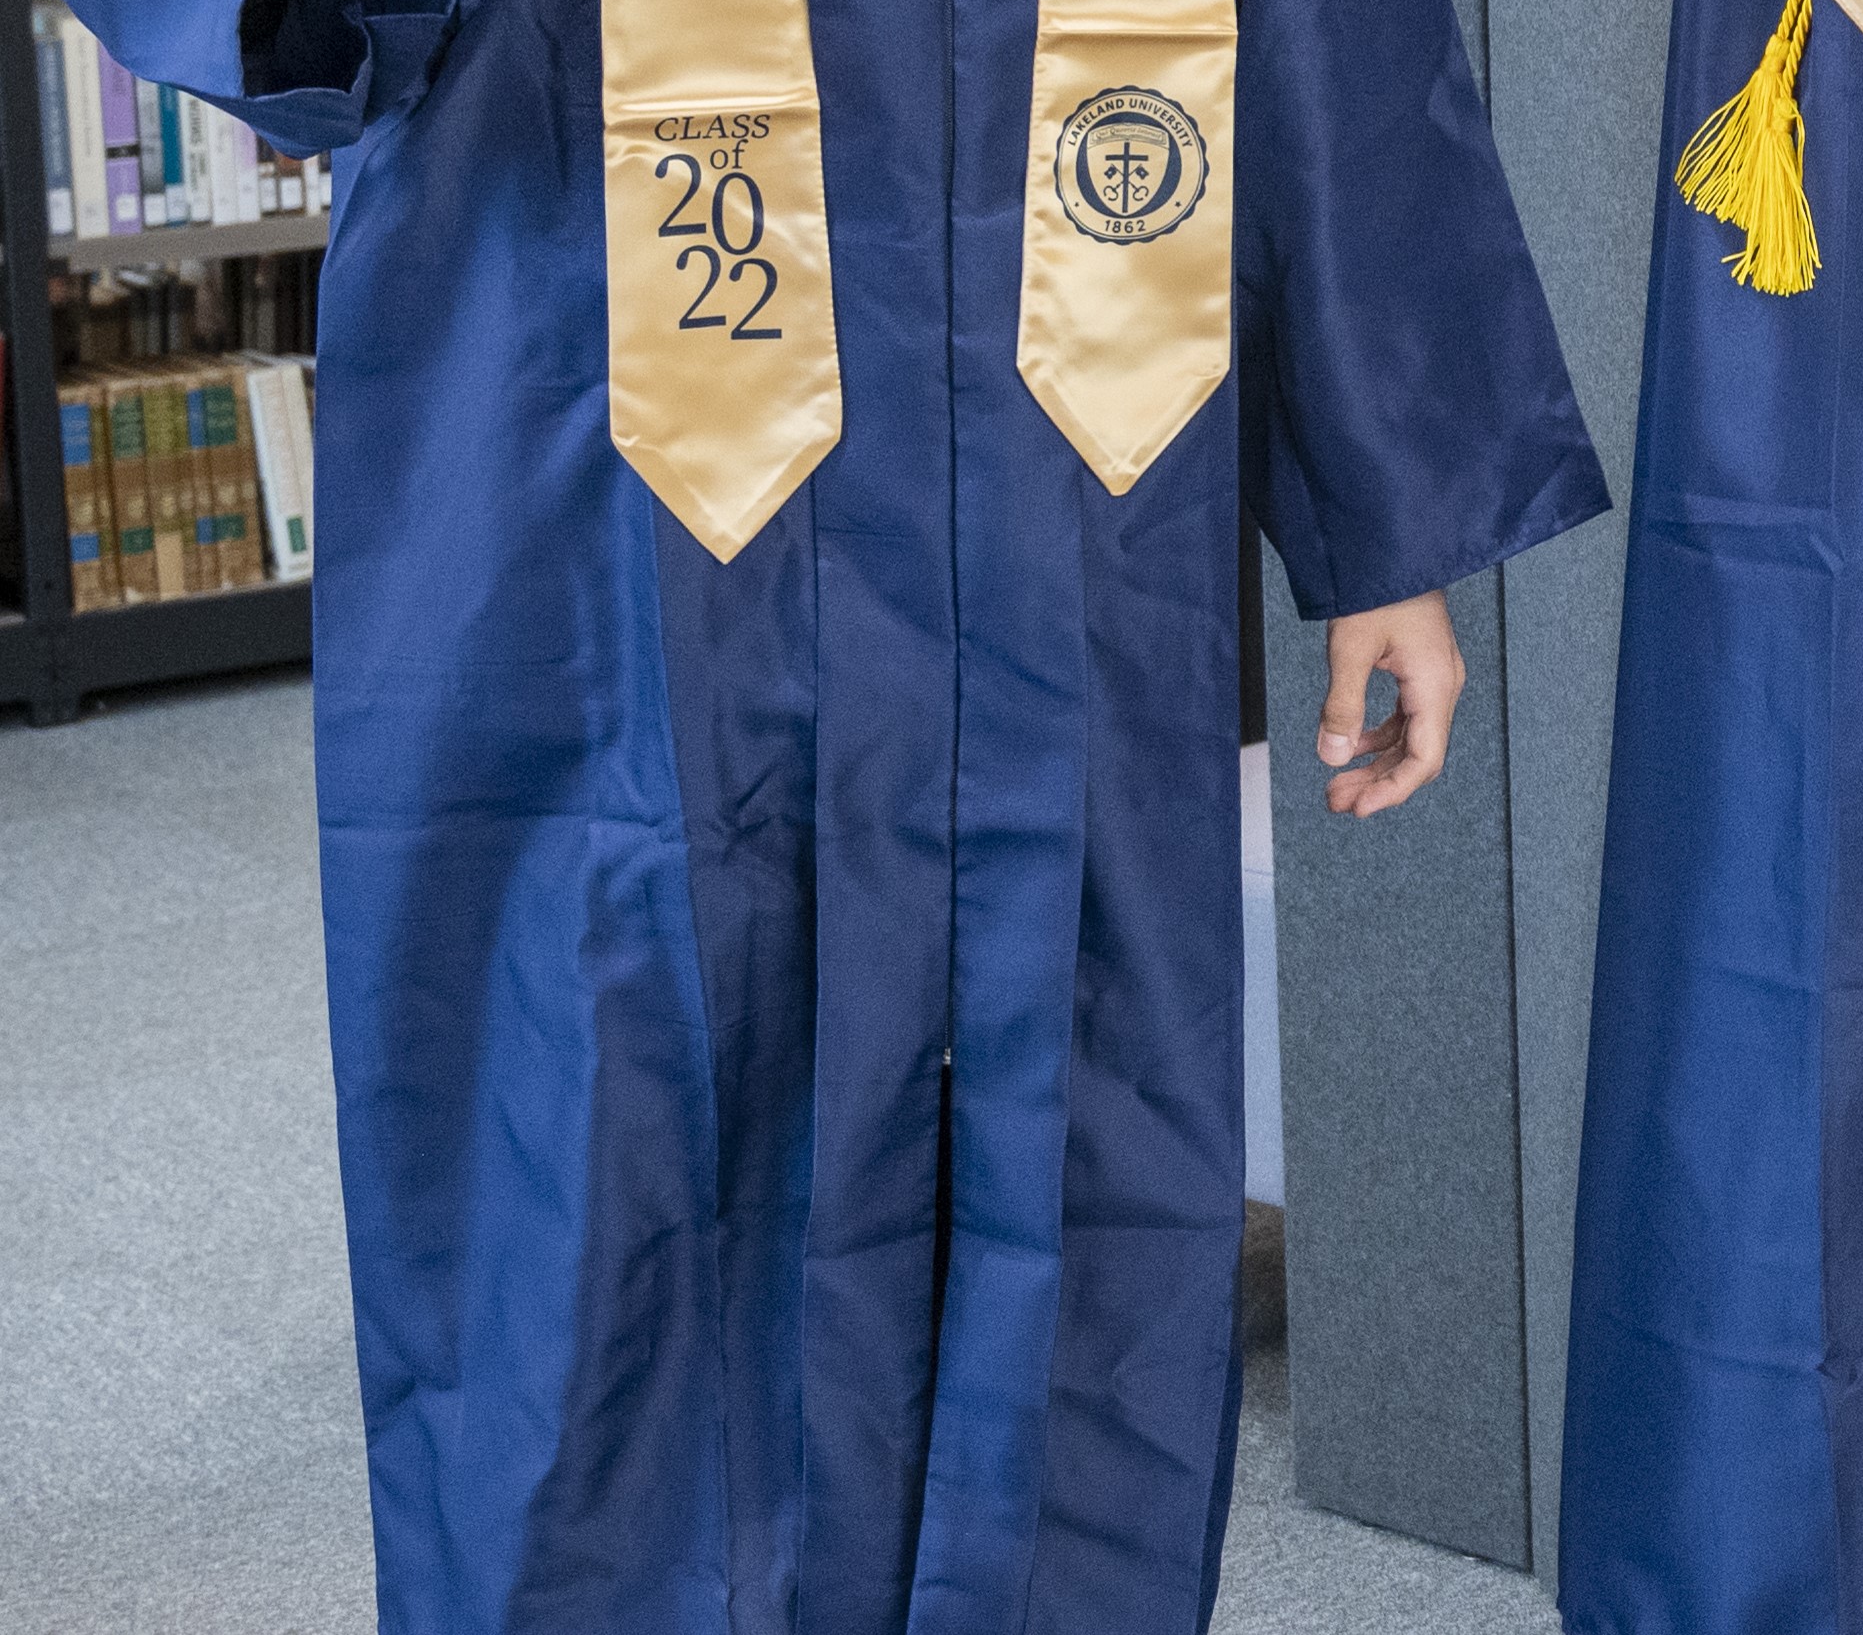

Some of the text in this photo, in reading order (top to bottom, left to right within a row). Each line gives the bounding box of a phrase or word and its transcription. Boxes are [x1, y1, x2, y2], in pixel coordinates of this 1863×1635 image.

[653, 114, 771, 142] CLASS
[1067, 97, 1194, 148] LAKELAND UNIVERSITY
[709, 138, 749, 170] of
[654, 153, 765, 256] 20
[1104, 219, 1147, 234] 1862
[675, 244, 783, 341] 22
